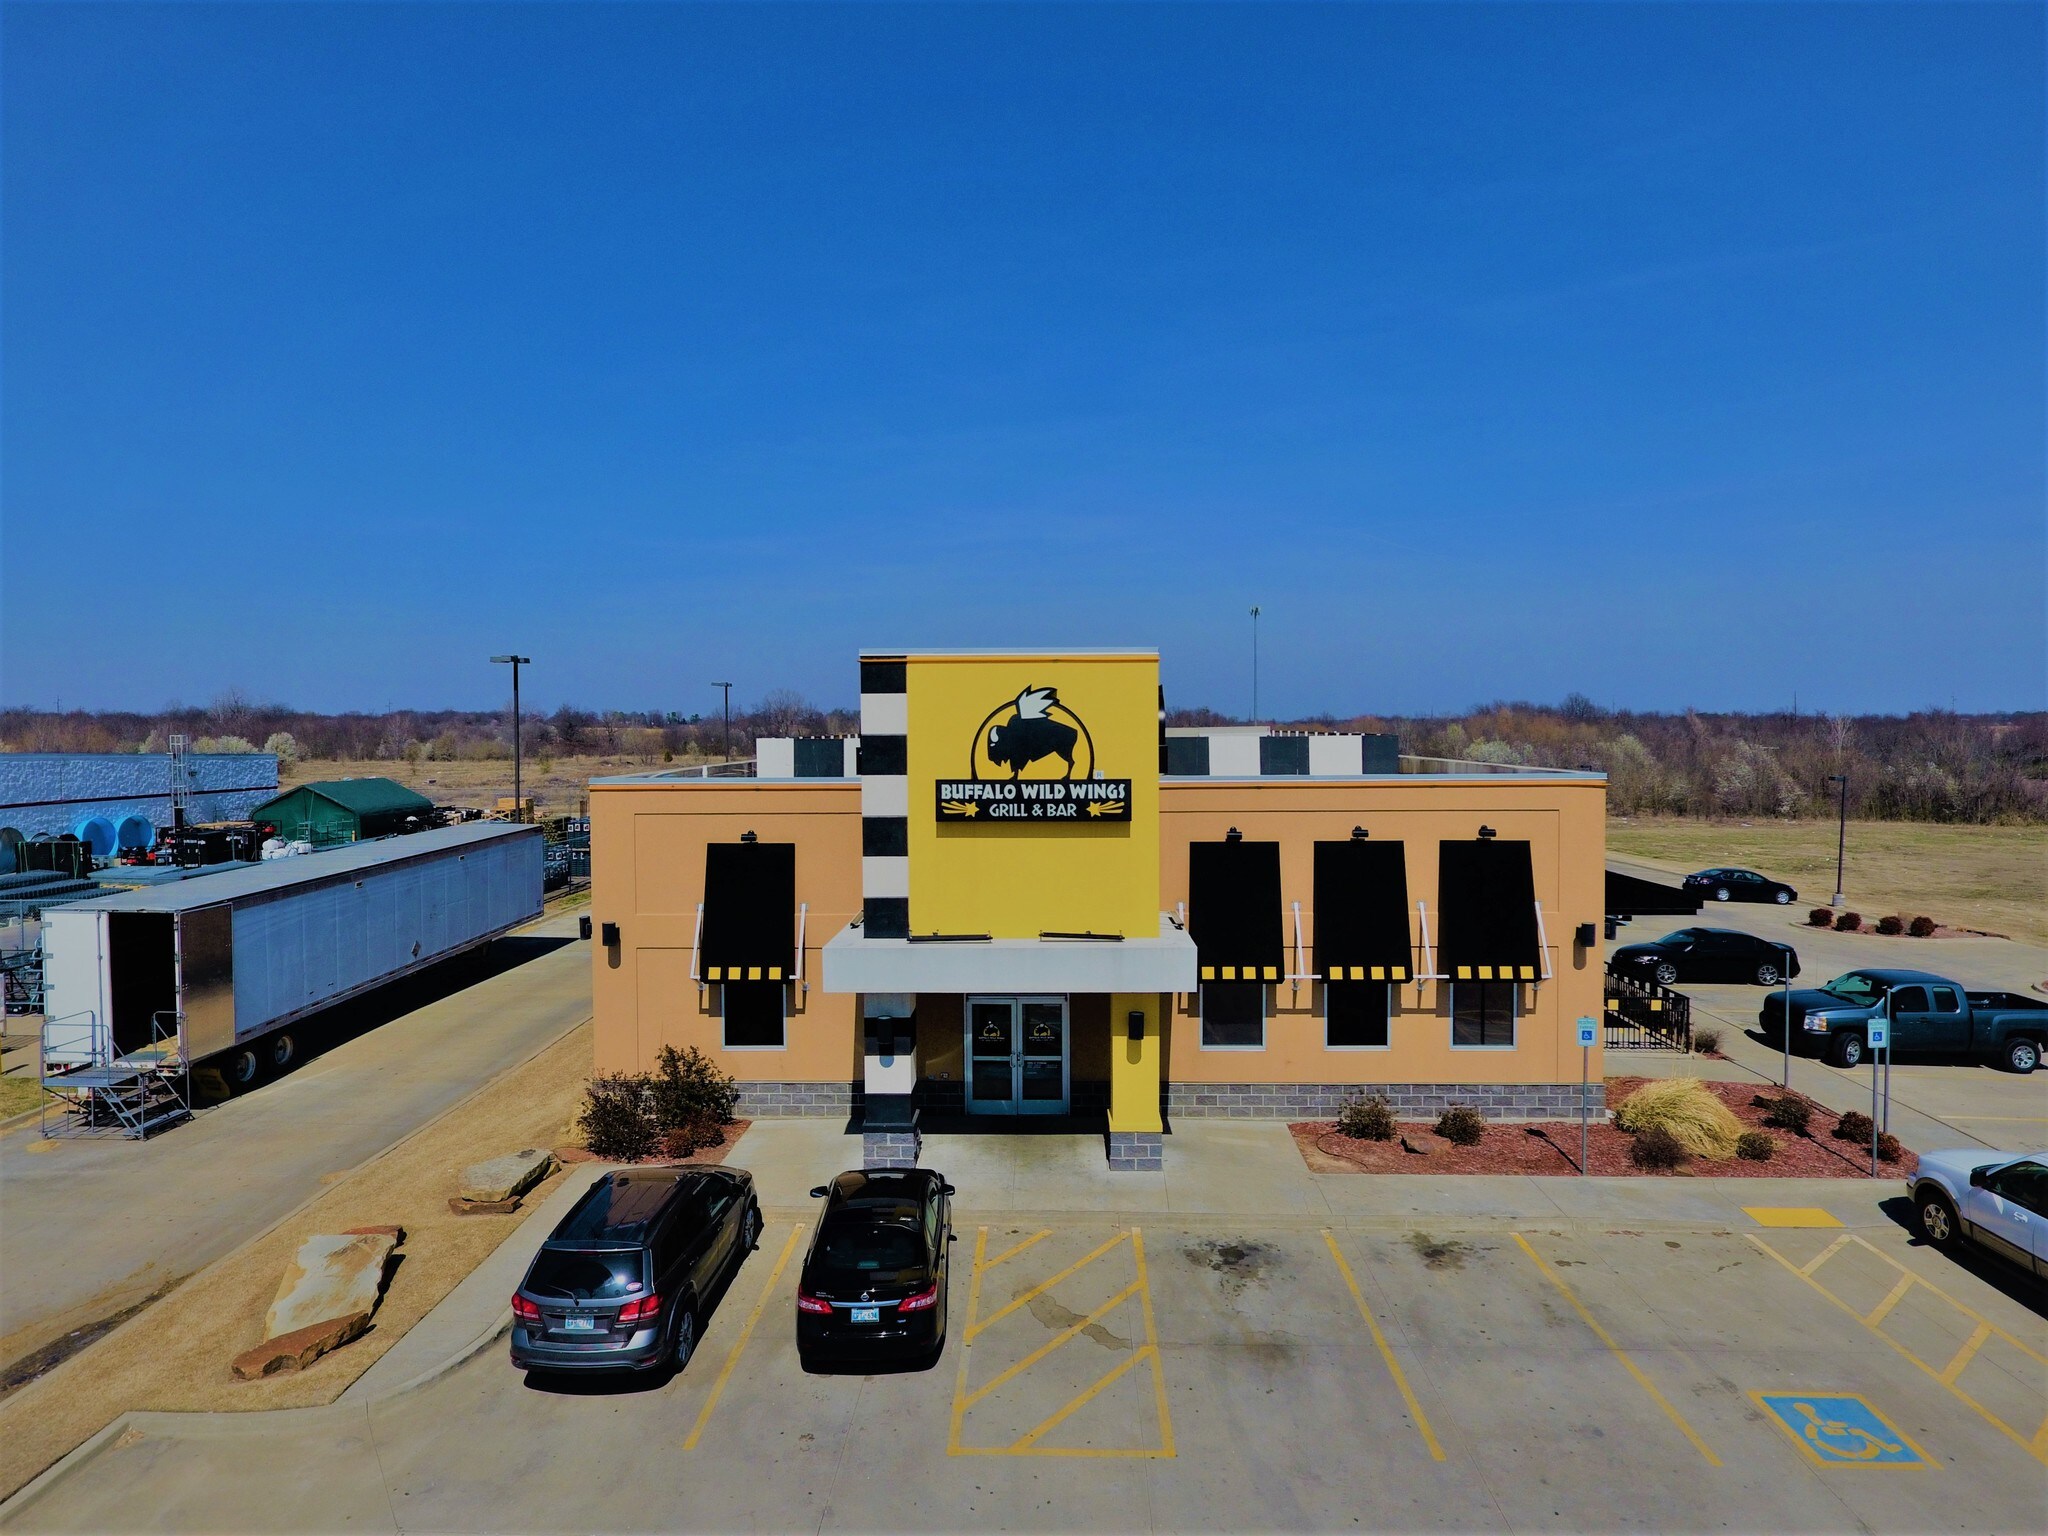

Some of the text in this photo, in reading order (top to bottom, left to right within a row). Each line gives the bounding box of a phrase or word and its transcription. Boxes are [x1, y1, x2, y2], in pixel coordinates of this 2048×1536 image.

[941, 783, 1126, 799] BUFFALO WILD WINGS
[989, 803, 1077, 817] GRILL & BAR
